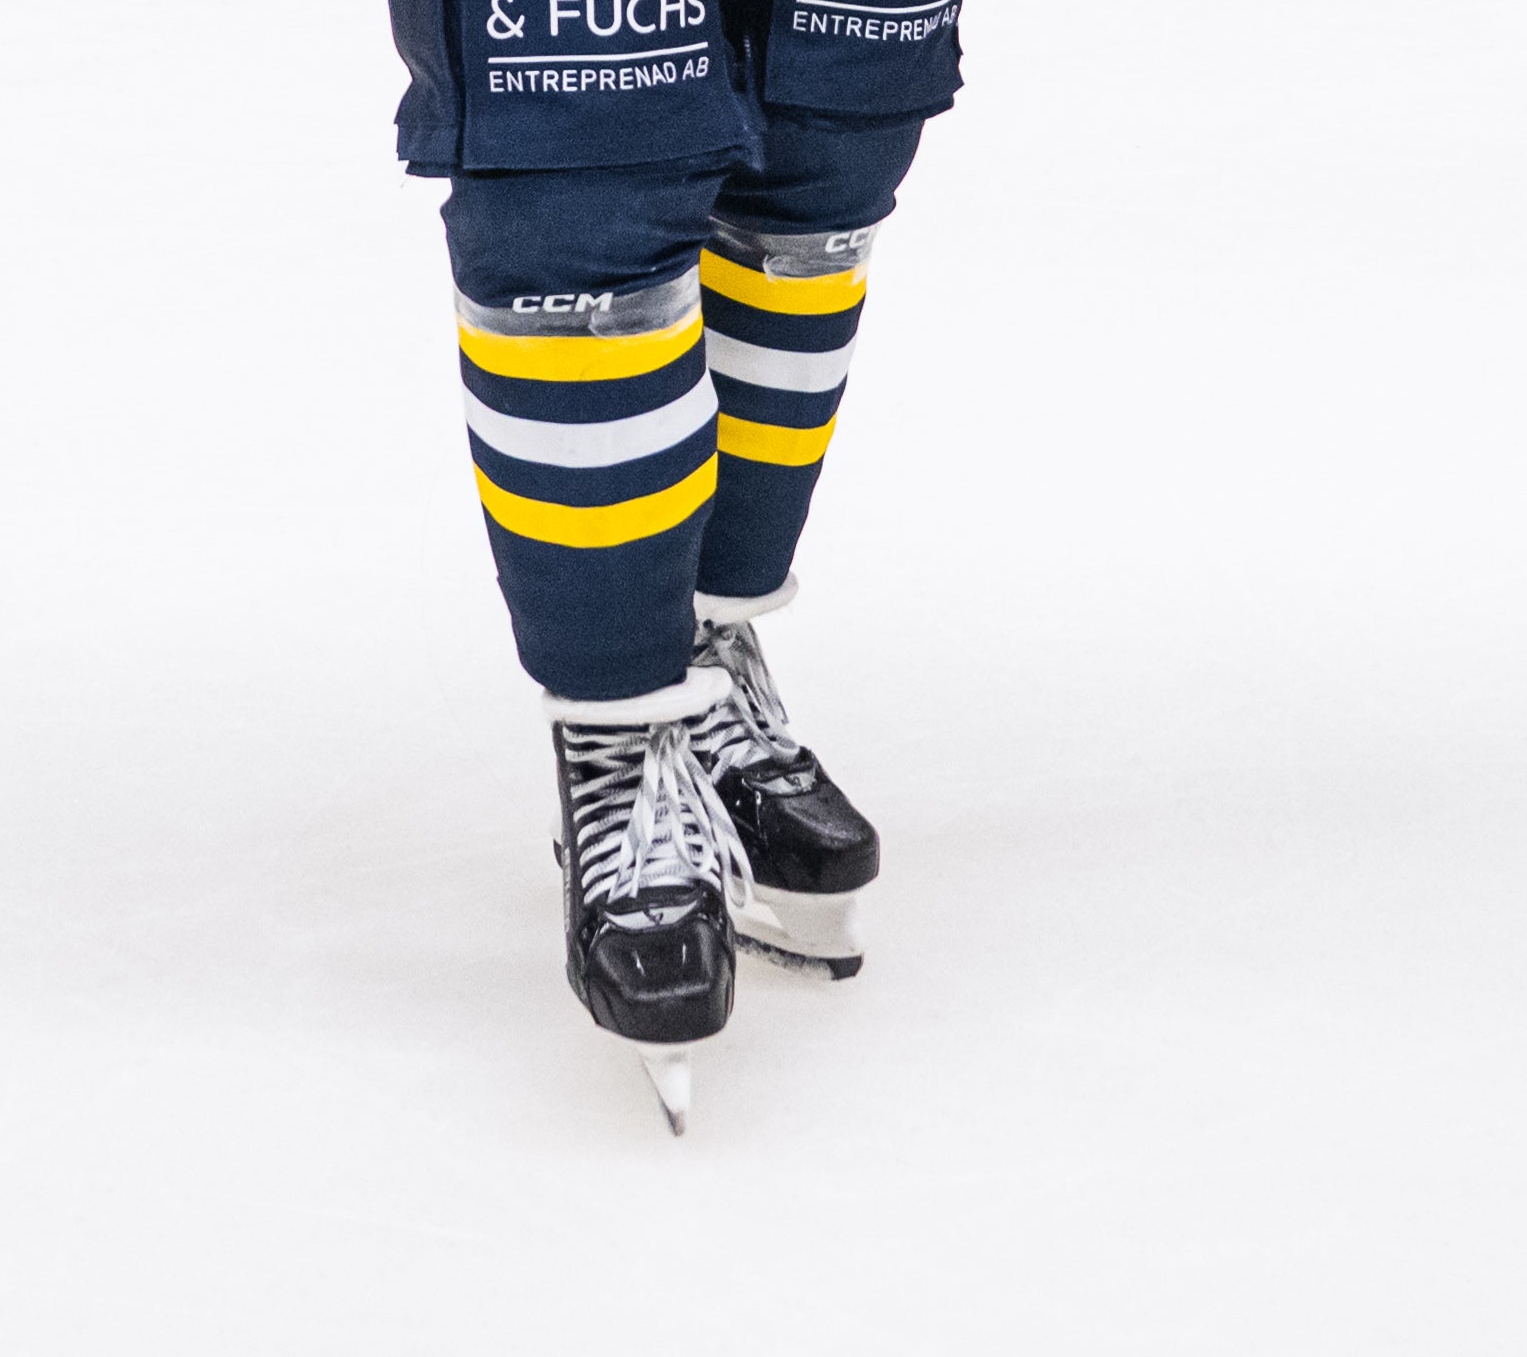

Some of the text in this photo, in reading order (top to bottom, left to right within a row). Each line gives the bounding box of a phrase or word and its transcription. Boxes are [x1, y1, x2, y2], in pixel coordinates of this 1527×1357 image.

[488, 55, 710, 93] ENTREPRENAD AB
[511, 291, 615, 316] CCM
